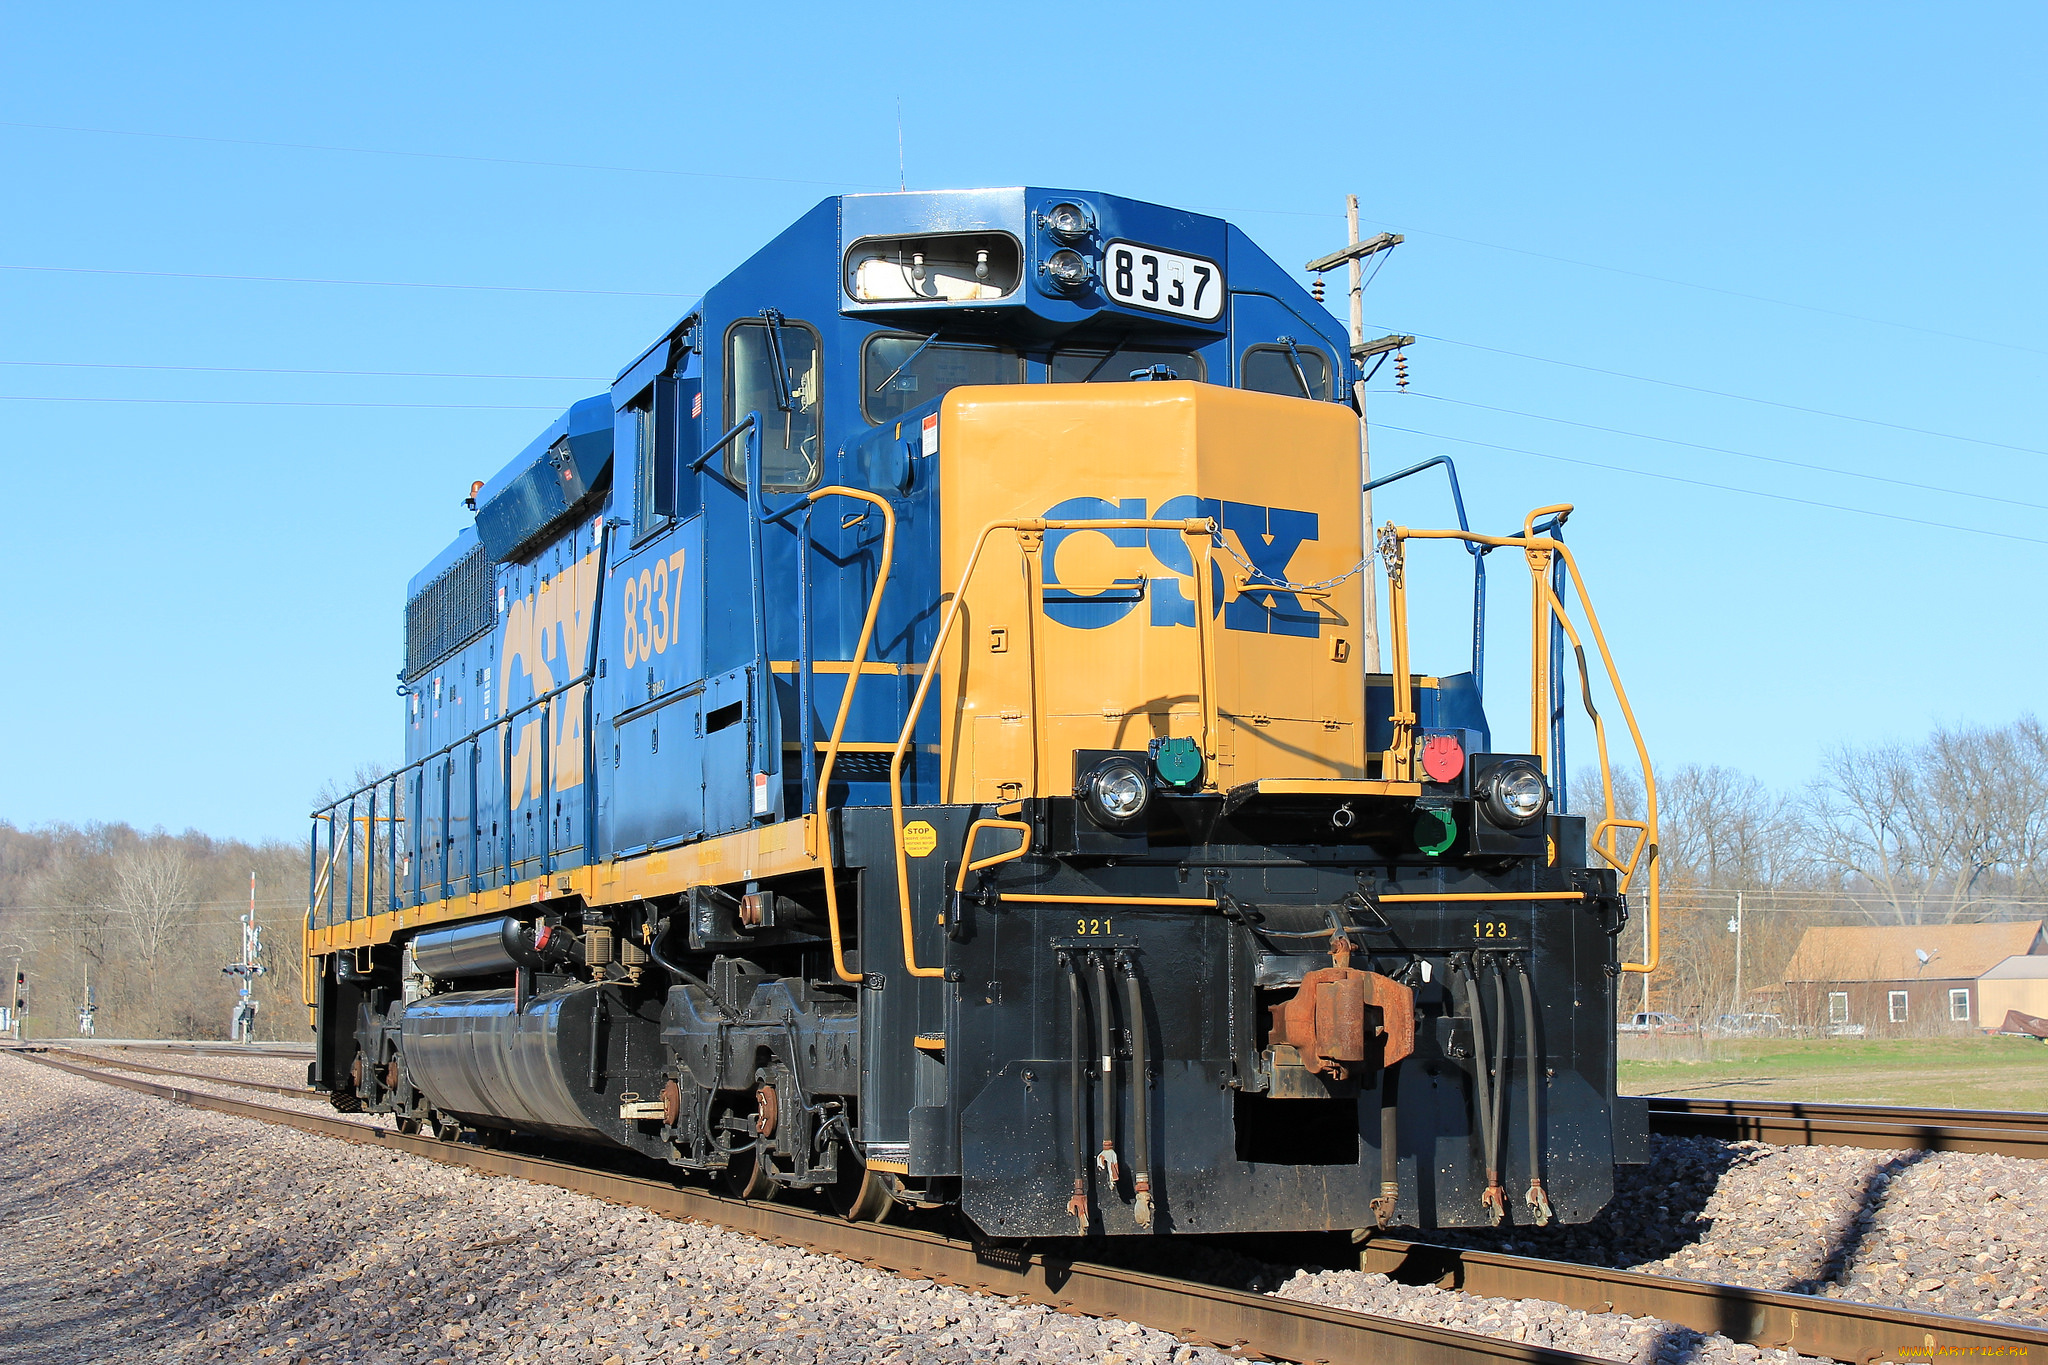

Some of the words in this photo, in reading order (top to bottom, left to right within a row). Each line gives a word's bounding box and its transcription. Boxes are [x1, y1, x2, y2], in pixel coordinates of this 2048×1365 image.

[1115, 249, 1211, 311] 8337
[1039, 495, 1320, 639] CSX
[624, 548, 686, 670] 8337
[498, 547, 603, 810] CSX
[907, 827, 930, 835] STOP
[1077, 919, 1112, 935] 321
[1473, 922, 1507, 938] 123
